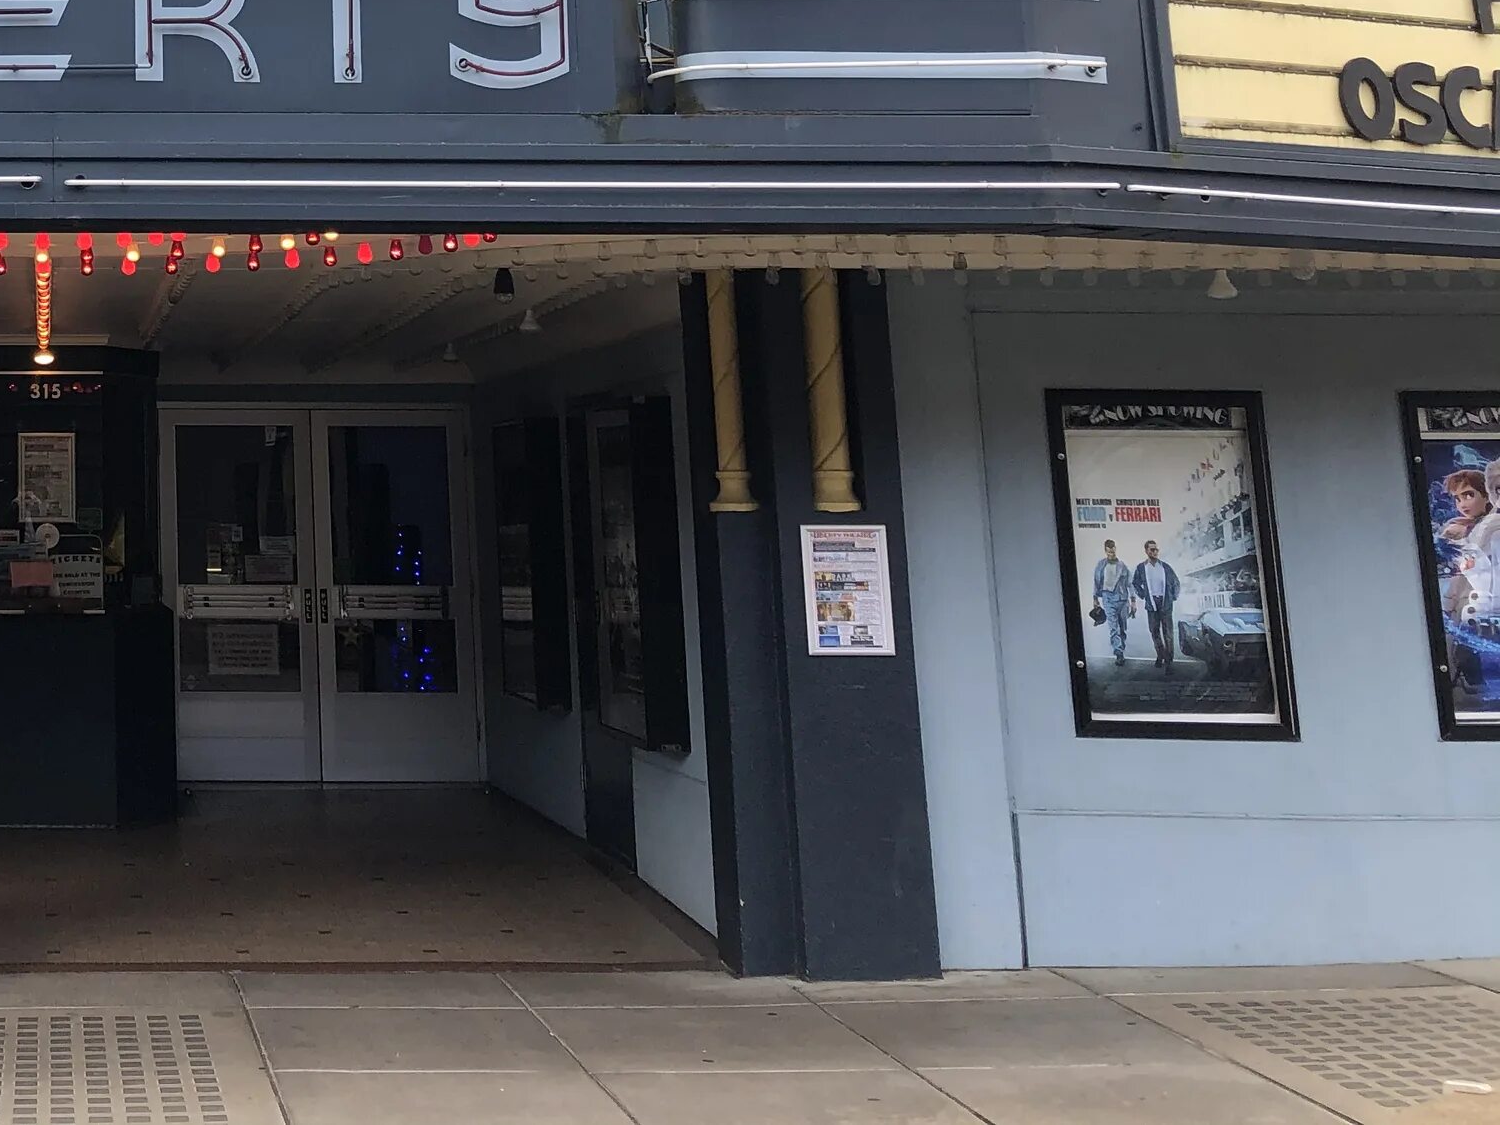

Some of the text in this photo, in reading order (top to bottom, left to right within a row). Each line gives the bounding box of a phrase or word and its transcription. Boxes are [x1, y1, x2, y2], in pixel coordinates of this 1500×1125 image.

[29, 383, 61, 400] 315
[1076, 498, 1091, 506] MATT
[1077, 507, 1107, 522] FORD
[1115, 507, 1162, 523] FERRARI
